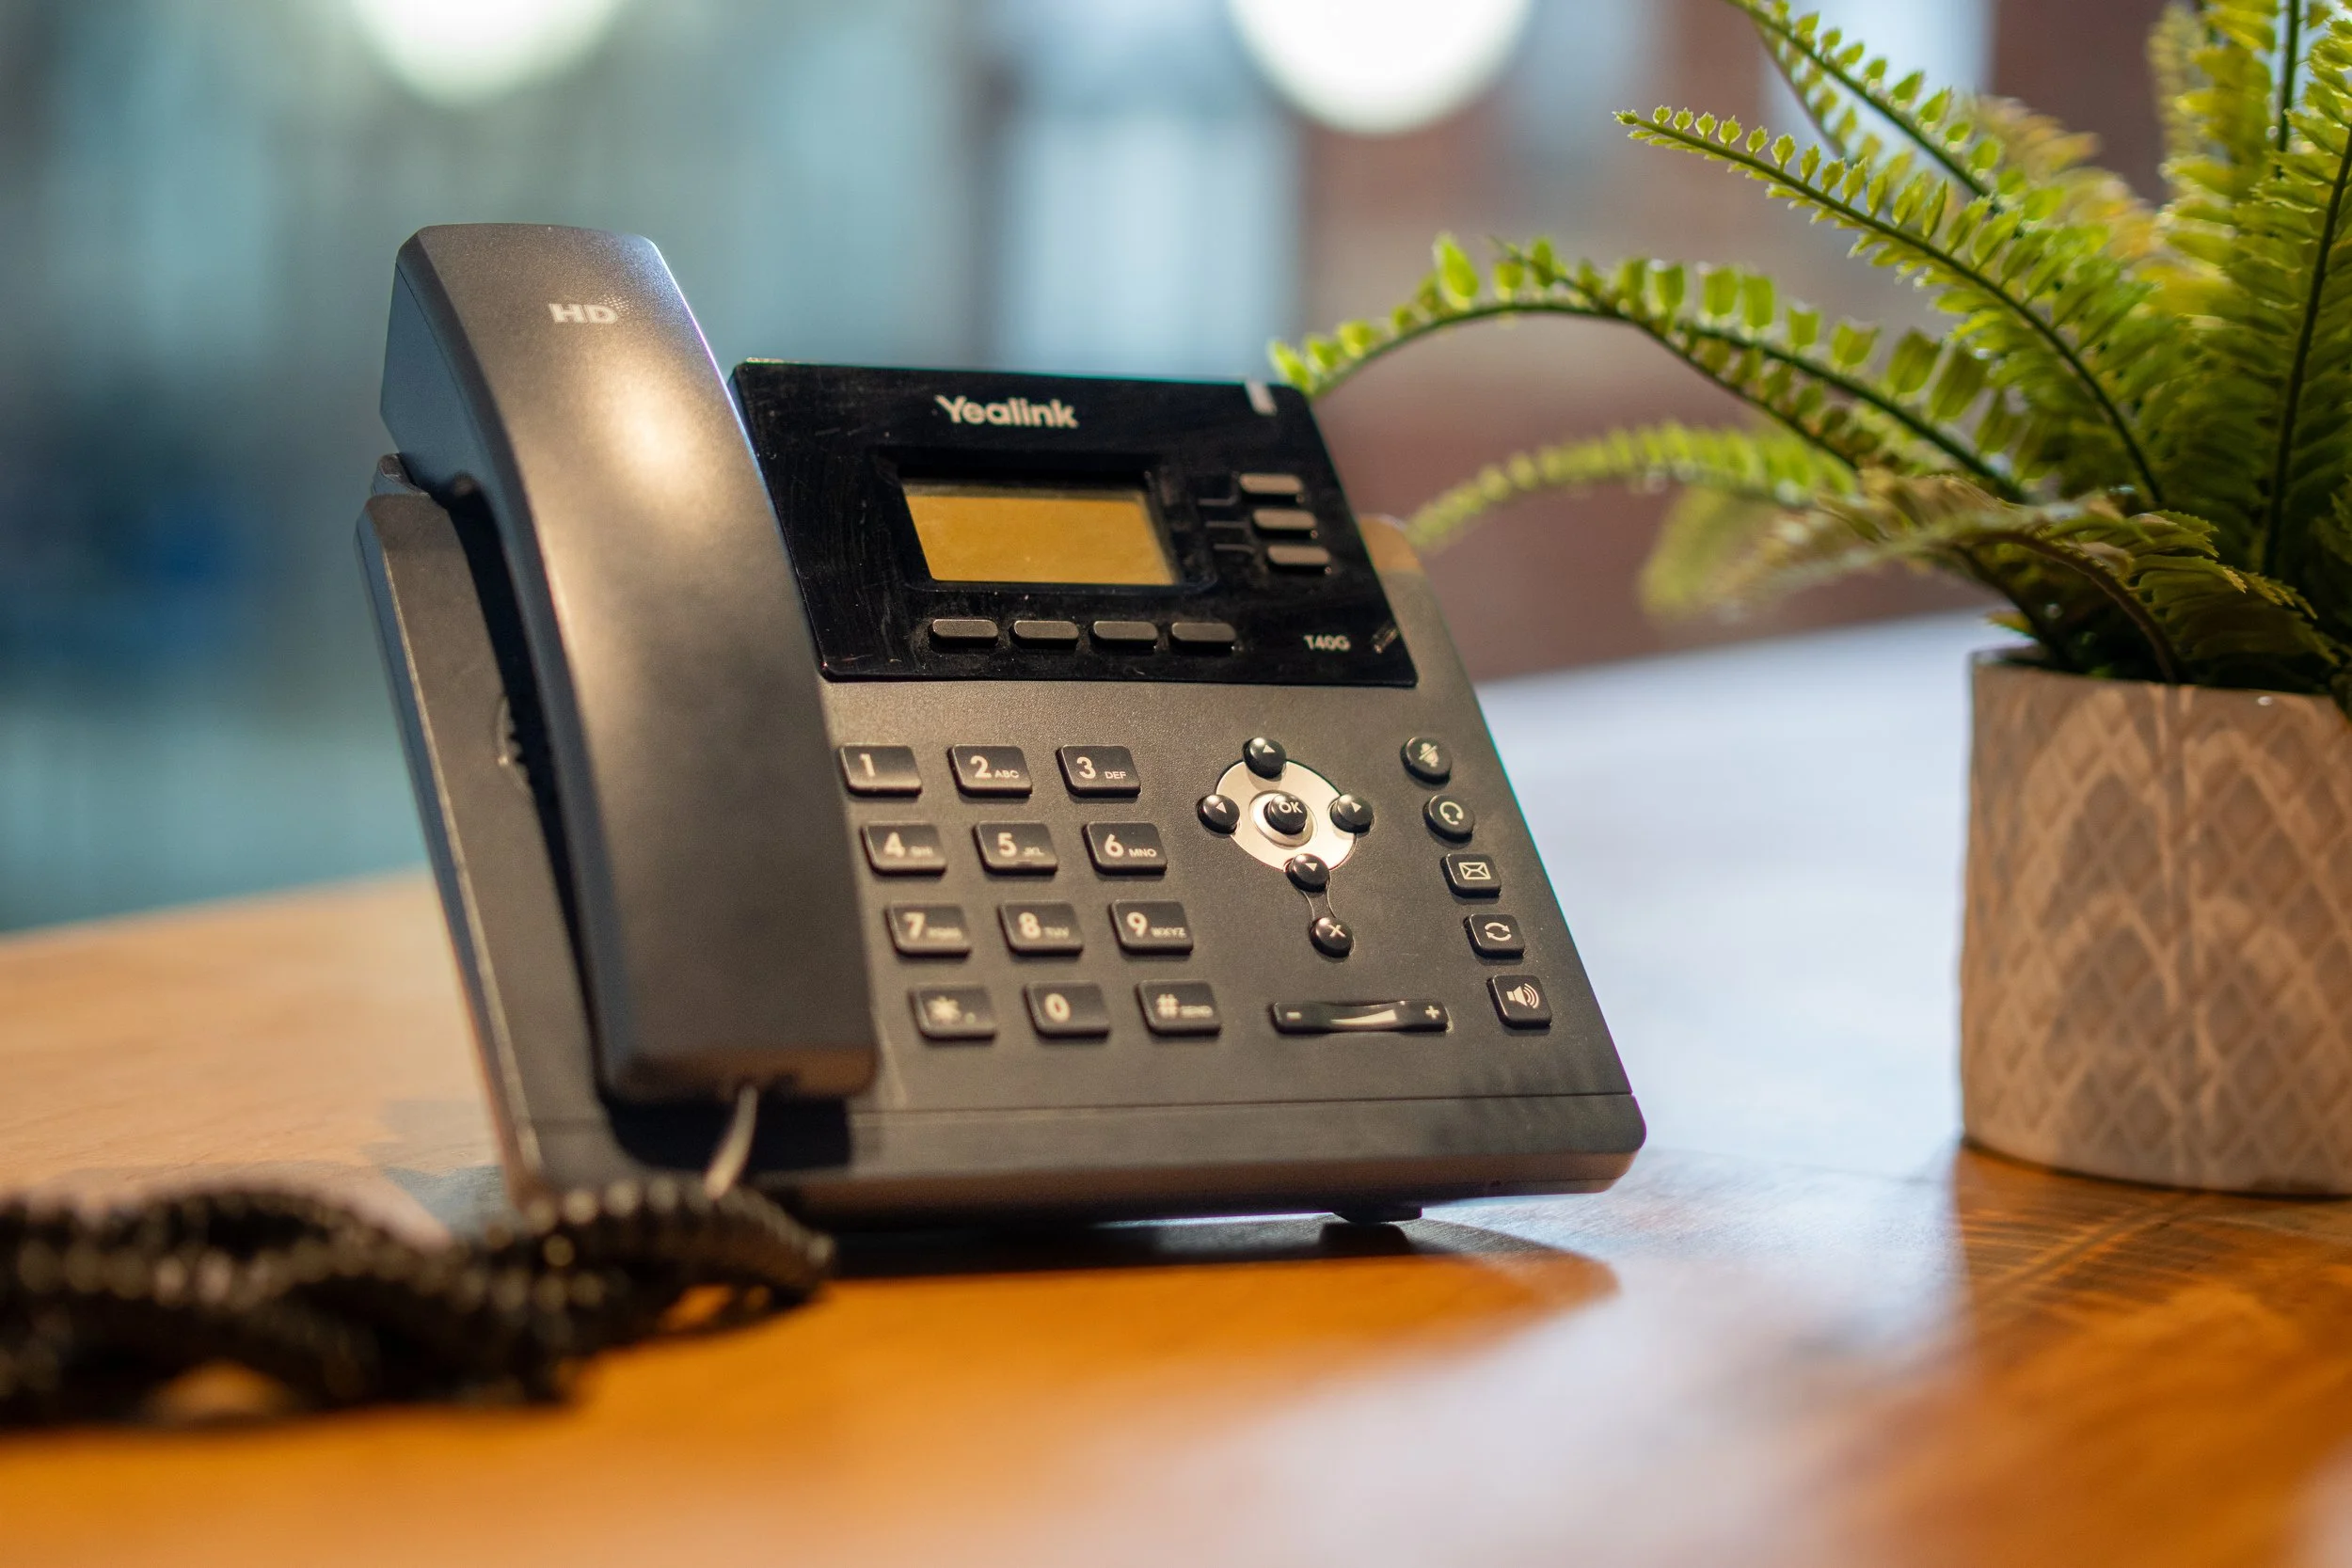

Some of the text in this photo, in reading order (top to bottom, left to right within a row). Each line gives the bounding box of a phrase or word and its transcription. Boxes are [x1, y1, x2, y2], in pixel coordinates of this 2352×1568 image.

[548, 303, 619, 324] HD
[934, 394, 1079, 429] Yealink
[1304, 635, 1351, 651] T40G
[859, 752, 876, 778] 1
[970, 755, 1019, 779] 2 ABC
[1076, 756, 1127, 780] 3 DEF
[1279, 801, 1303, 814] OK
[883, 832, 906, 858] 4
[997, 832, 1017, 857] 5
[1104, 833, 1157, 858] 6 MNO
[903, 911, 925, 940] 7
[1018, 911, 1041, 939] 8
[1126, 911, 1148, 938] 9
[1044, 993, 1071, 1022] 0
